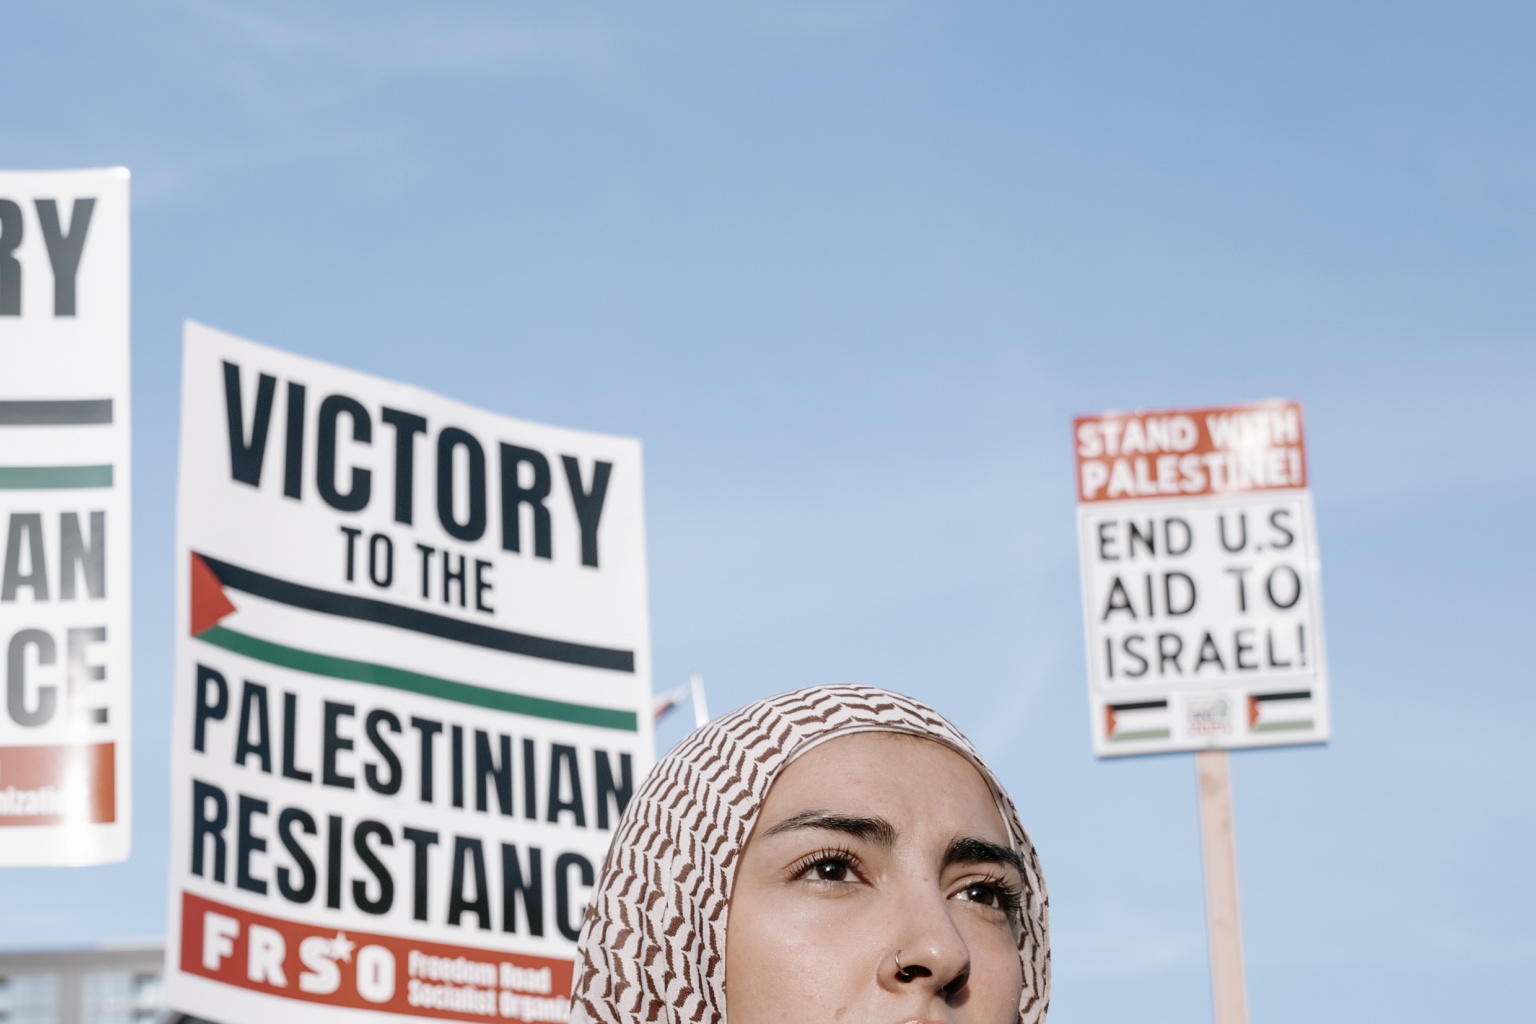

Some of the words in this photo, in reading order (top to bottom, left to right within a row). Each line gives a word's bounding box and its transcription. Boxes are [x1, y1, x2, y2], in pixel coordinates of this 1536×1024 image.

[222, 360, 613, 569] VICTORY
[1076, 415, 1198, 457] STAND
[1080, 449, 1302, 499] PALESTINE!
[1097, 517, 1192, 562] END
[340, 526, 393, 588] TO
[415, 543, 495, 615] THE
[1102, 571, 1197, 622] AID
[1225, 564, 1301, 613] TO
[1105, 624, 1306, 679] ISRAEL!
[193, 662, 634, 830] PALESTINIAN
[191, 779, 595, 943] RESISTANC
[202, 911, 396, 1003] FRSO
[408, 949, 497, 989] Freedom
[499, 961, 552, 995] Road
[407, 978, 497, 1017] Socialist
